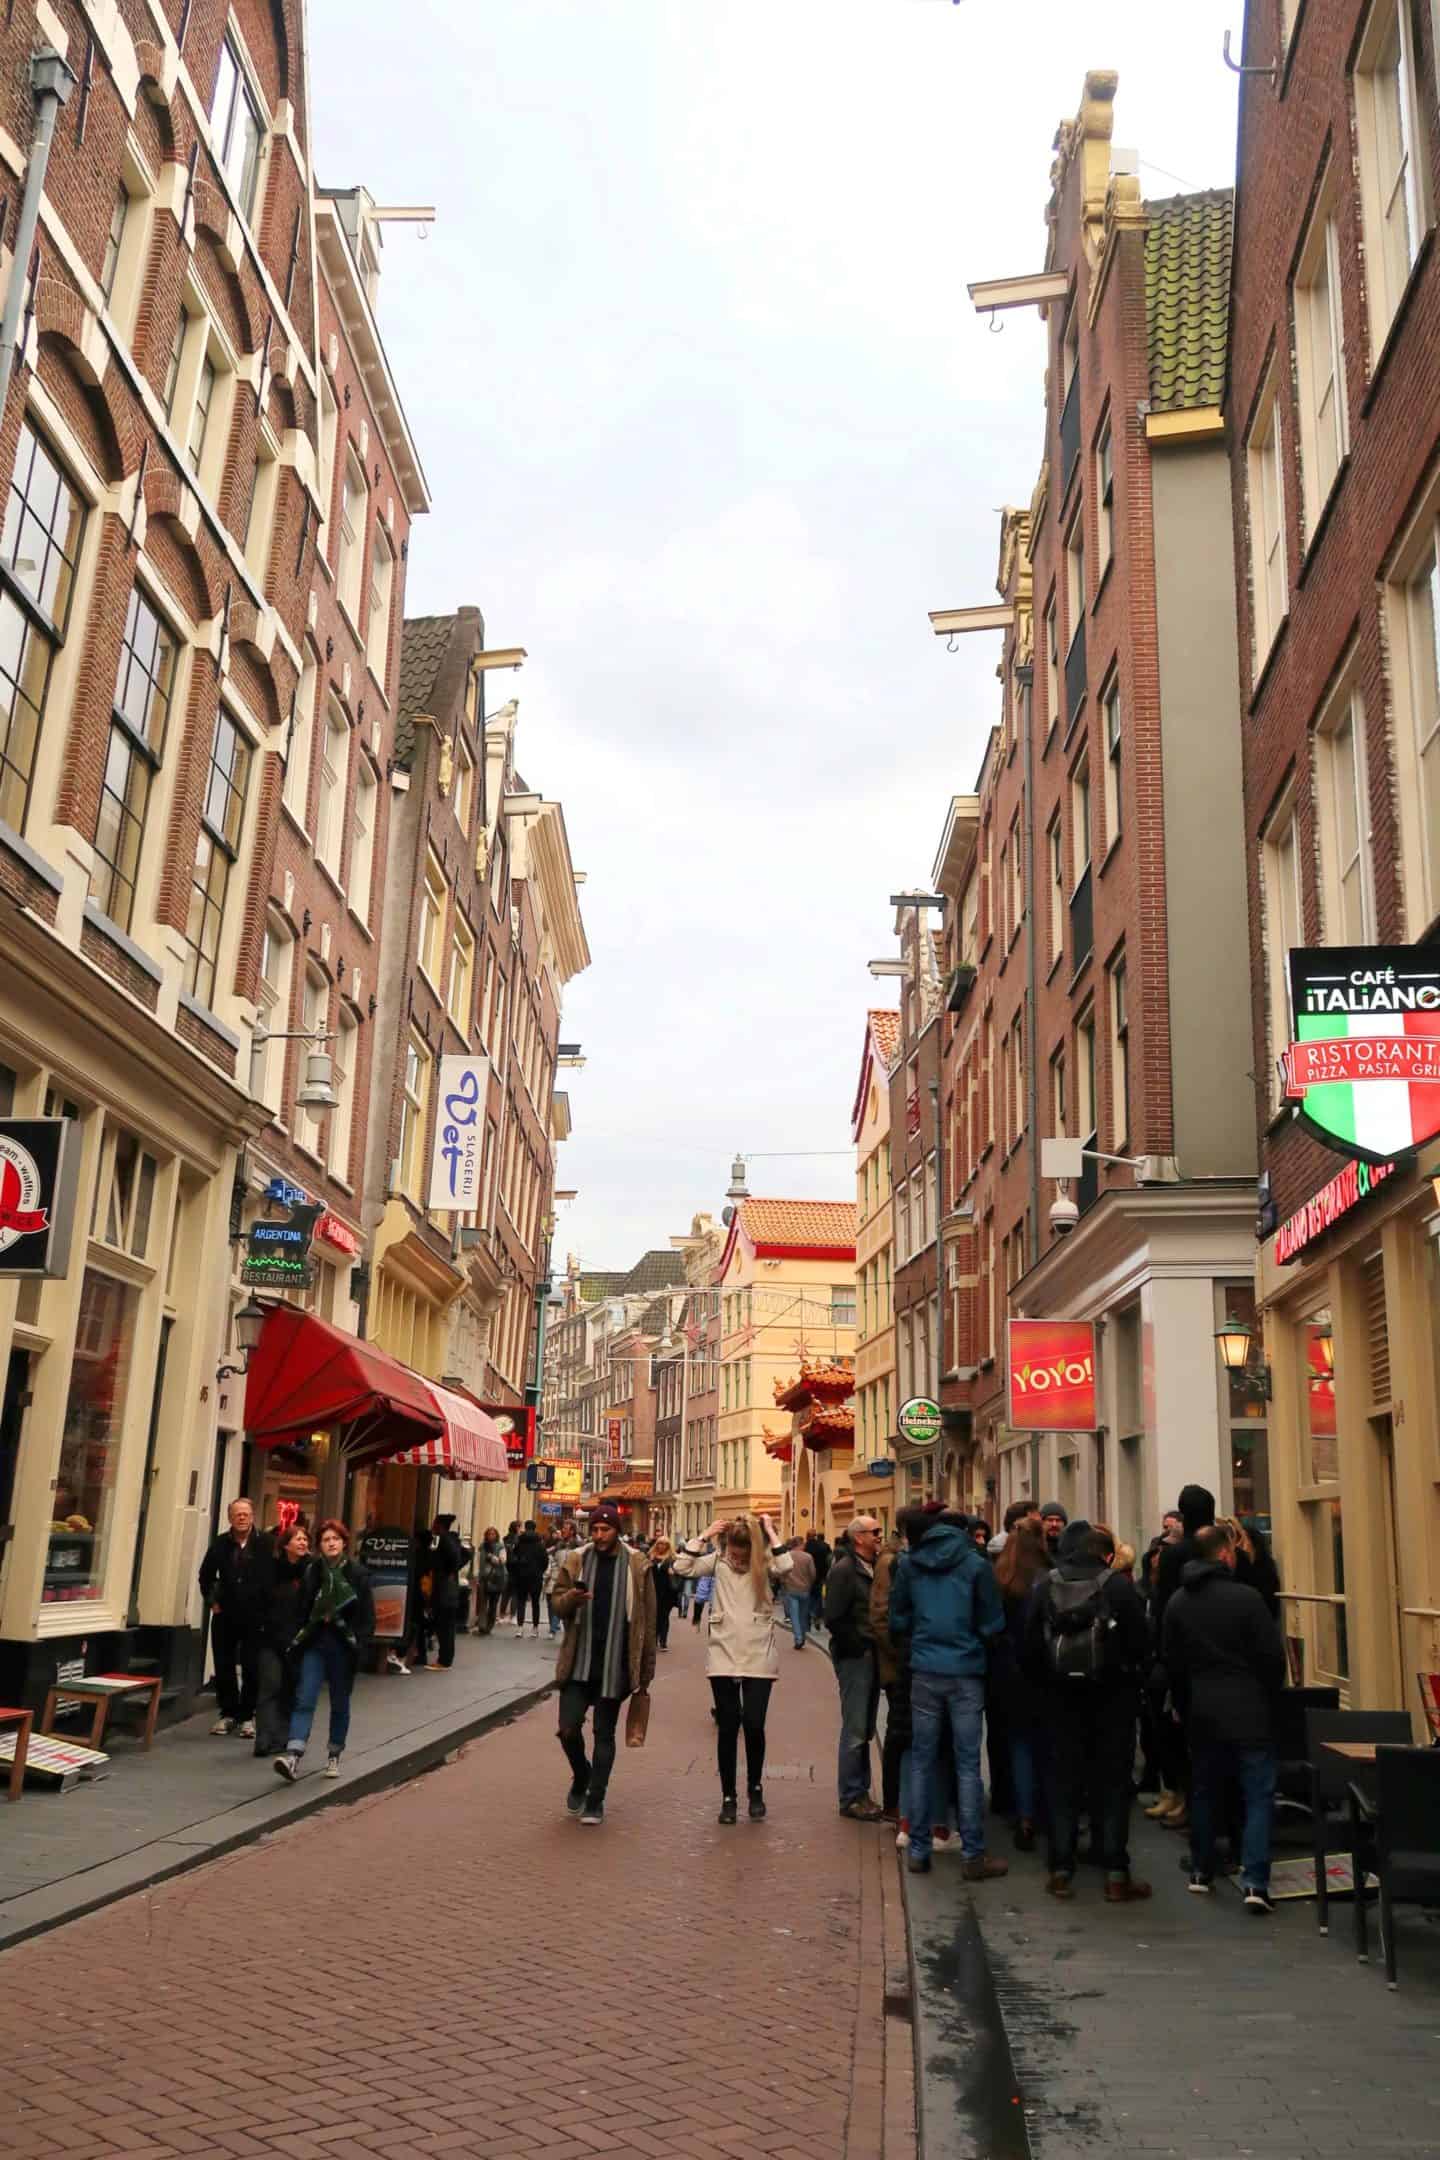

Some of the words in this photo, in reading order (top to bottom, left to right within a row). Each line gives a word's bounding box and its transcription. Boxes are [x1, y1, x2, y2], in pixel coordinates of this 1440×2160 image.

[1350, 965, 1396, 986] CAFÉ
[1307, 1042, 1440, 1066] RISTORANT
[1307, 1064, 1348, 1081] PIZZA
[1358, 1062, 1401, 1075] PASTA
[1411, 1064, 1440, 1077] GRI
[441, 1070, 479, 1198] Vet
[463, 1135, 476, 1195] SLAGERIJ
[242, 1270, 305, 1284] RESTAURANT
[1013, 1356, 1093, 1393] YOYO!
